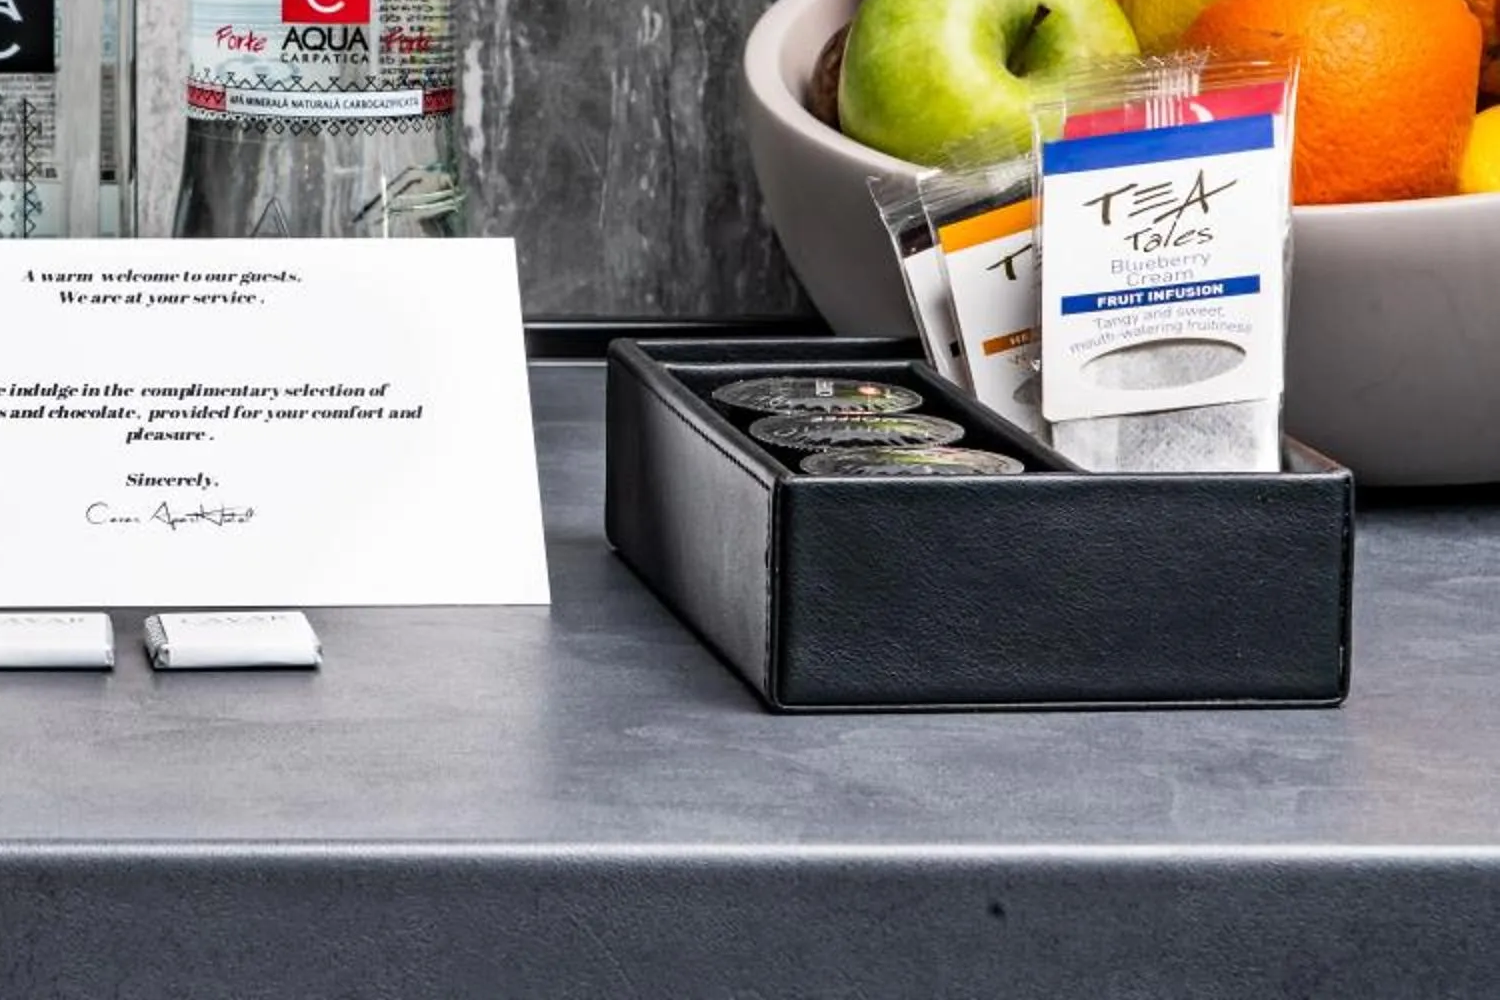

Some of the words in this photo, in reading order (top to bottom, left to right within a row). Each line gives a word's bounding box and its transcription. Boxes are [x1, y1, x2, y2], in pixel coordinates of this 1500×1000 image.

[215, 24, 269, 52] Forte
[281, 26, 369, 51] AQUA
[280, 53, 370, 65] CARPATICA
[291, 97, 340, 110] NATURALĂ
[1082, 168, 1238, 226] TEA
[1124, 219, 1214, 253] Tales
[1110, 252, 1212, 275] Blueberry
[23, 269, 35, 283] A
[41, 273, 93, 283] warm
[101, 269, 180, 283] welcome
[182, 271, 202, 283] to
[204, 273, 239, 283] our
[1126, 268, 1195, 287] Cream
[59, 290, 88, 304] We
[90, 294, 123, 304] are
[124, 292, 143, 304] at
[146, 294, 191, 307] your
[1096, 292, 1145, 309] FRUIT
[1147, 283, 1225, 302] INFUSION
[1092, 313, 1139, 331] Tangy
[1143, 307, 1174, 320] and
[1069, 321, 1184, 355] mouth-watering
[1186, 318, 1254, 335] fruitiness
[9, 382, 79, 401] indulge
[81, 383, 101, 397] in
[103, 383, 135, 397] the
[140, 383, 279, 401] complimentary
[284, 383, 366, 397] selection
[368, 383, 390, 397] of
[9, 405, 46, 419] and
[147, 405, 231, 423] provided
[232, 405, 263, 419] for
[263, 409, 309, 423] your
[311, 405, 384, 419] comfort
[388, 405, 423, 419] and
